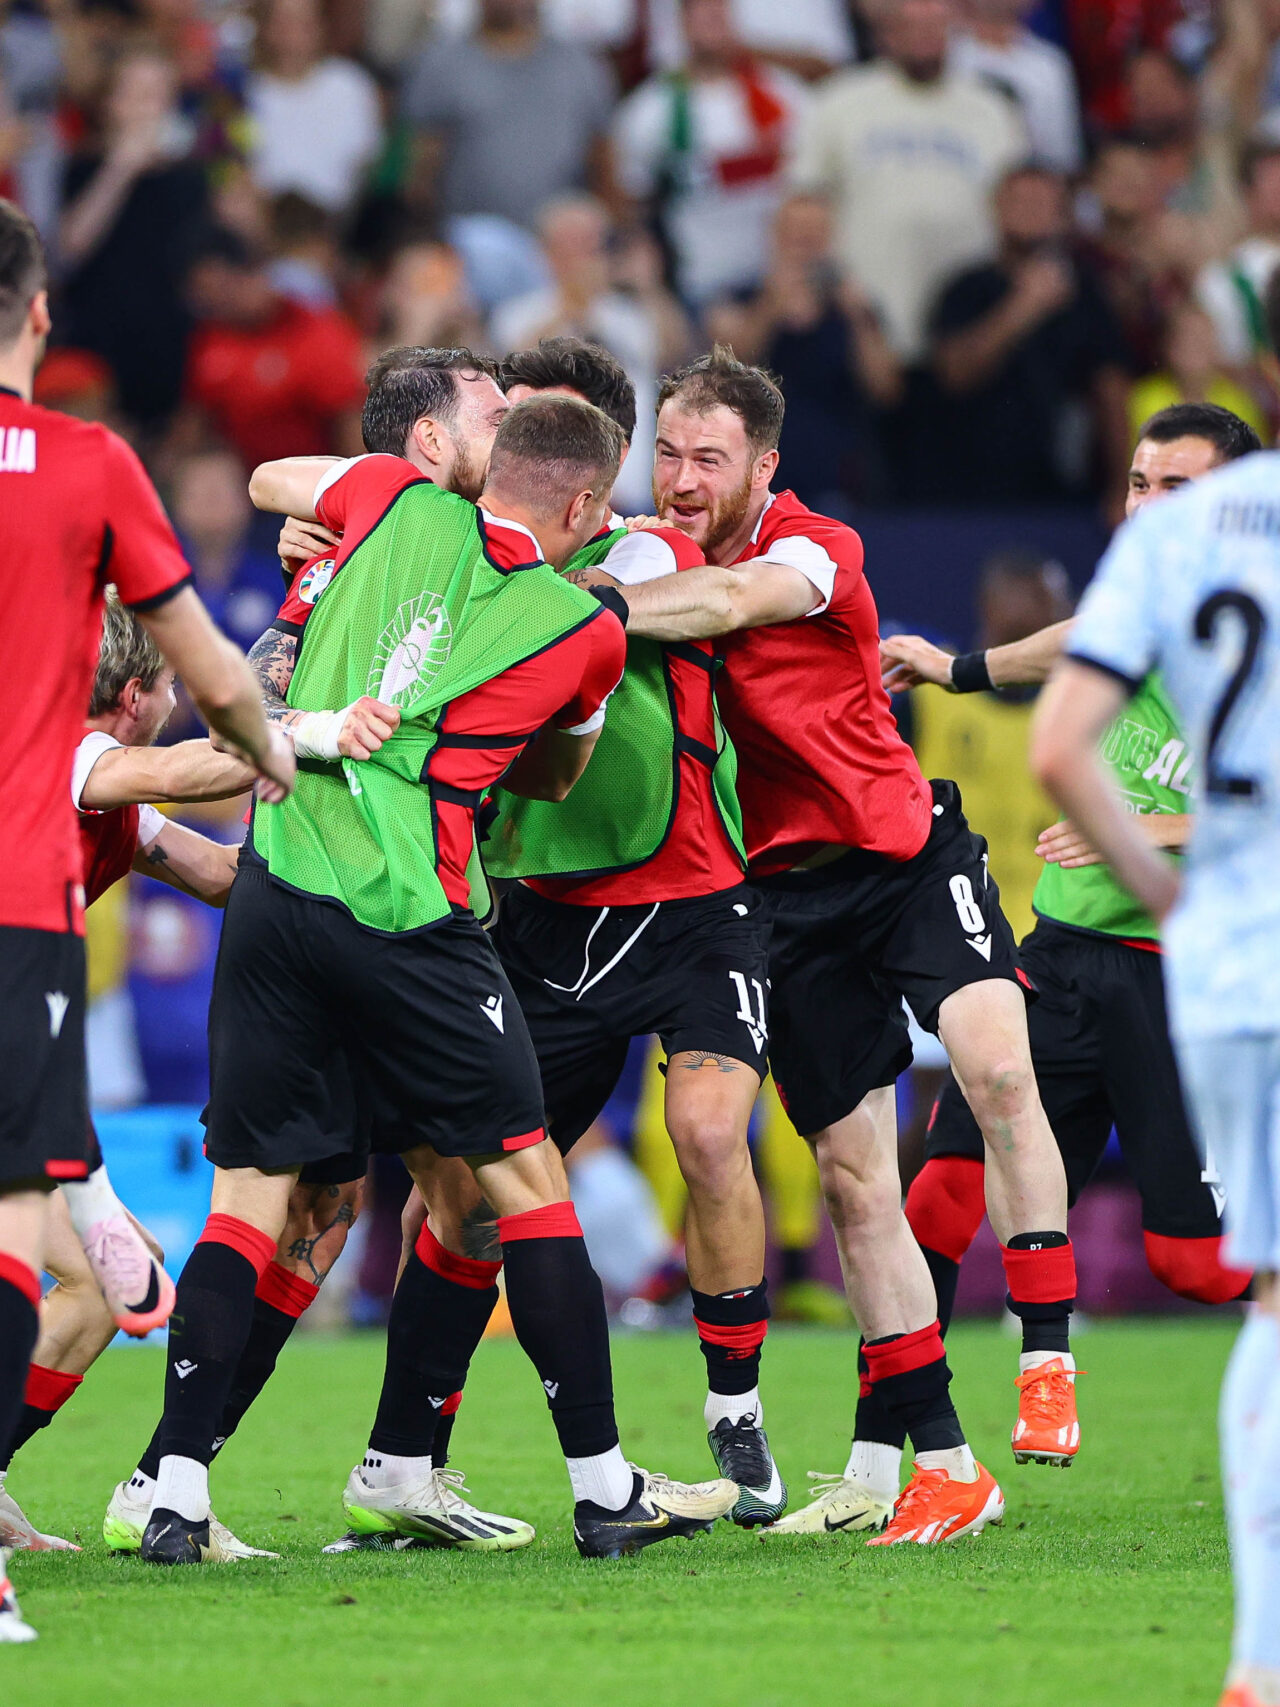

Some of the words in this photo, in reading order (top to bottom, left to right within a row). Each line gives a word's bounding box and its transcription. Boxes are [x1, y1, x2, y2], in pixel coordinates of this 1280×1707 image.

[1193, 587, 1270, 798] 2
[948, 873, 986, 934] 8
[728, 969, 769, 1041] 11
